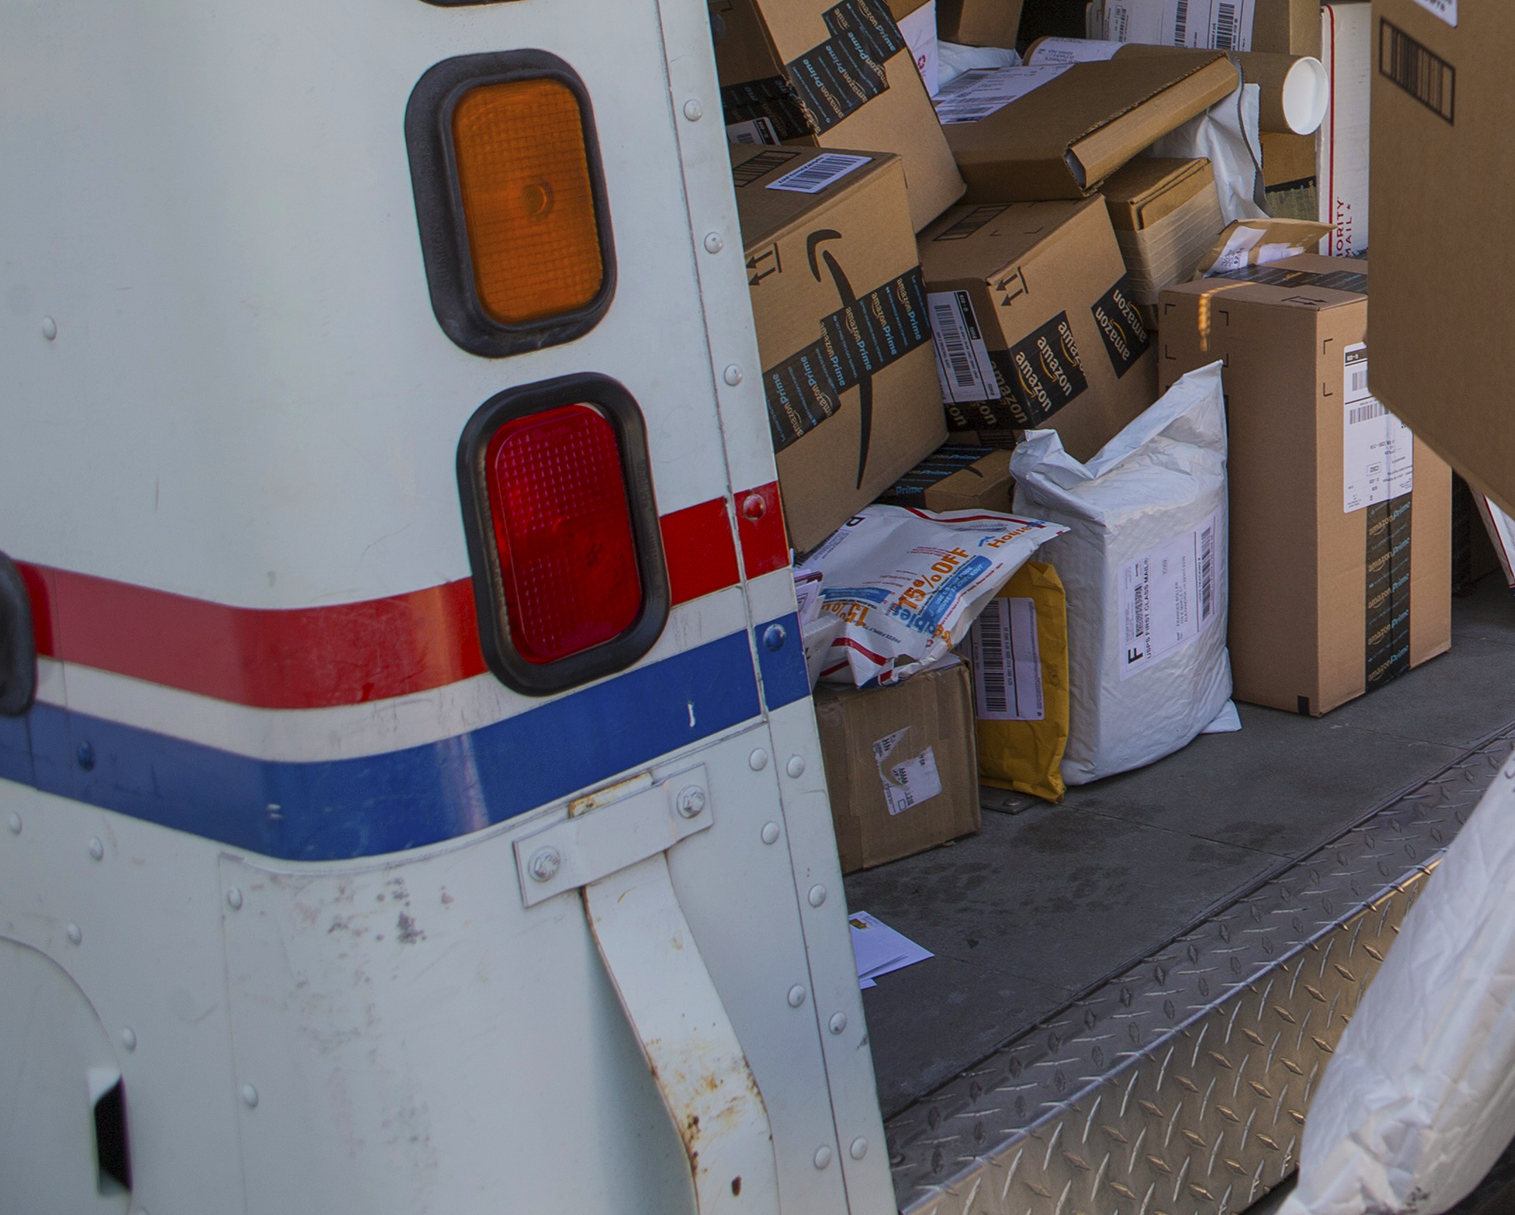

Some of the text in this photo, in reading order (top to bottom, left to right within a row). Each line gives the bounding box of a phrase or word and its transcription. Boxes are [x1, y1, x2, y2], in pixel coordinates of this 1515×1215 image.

[803, 58, 845, 119] amazonPrime
[826, 45, 868, 103] amazonPrime
[872, 292, 897, 355] amazonPrime
[897, 277, 921, 341] amazonPrime
[1095, 307, 1130, 361] amazon
[1113, 289, 1146, 342] amazon
[820, 321, 845, 386] amazonPrime
[846, 307, 872, 370] amazonPrime
[1037, 336, 1072, 396] amazon
[773, 373, 804, 436] amazonPrime
[801, 356, 832, 417] amazonPrime
[1016, 351, 1052, 412] amazon
[1369, 502, 1411, 535] amazonPrime
[931, 547, 969, 575] OFF
[1368, 537, 1410, 572] amazonPrime
[1368, 573, 1409, 608] amazonPrime
[1128, 647, 1143, 664] F
[1368, 609, 1409, 645] amazonPrime
[1368, 645, 1409, 681] amazonPrime
